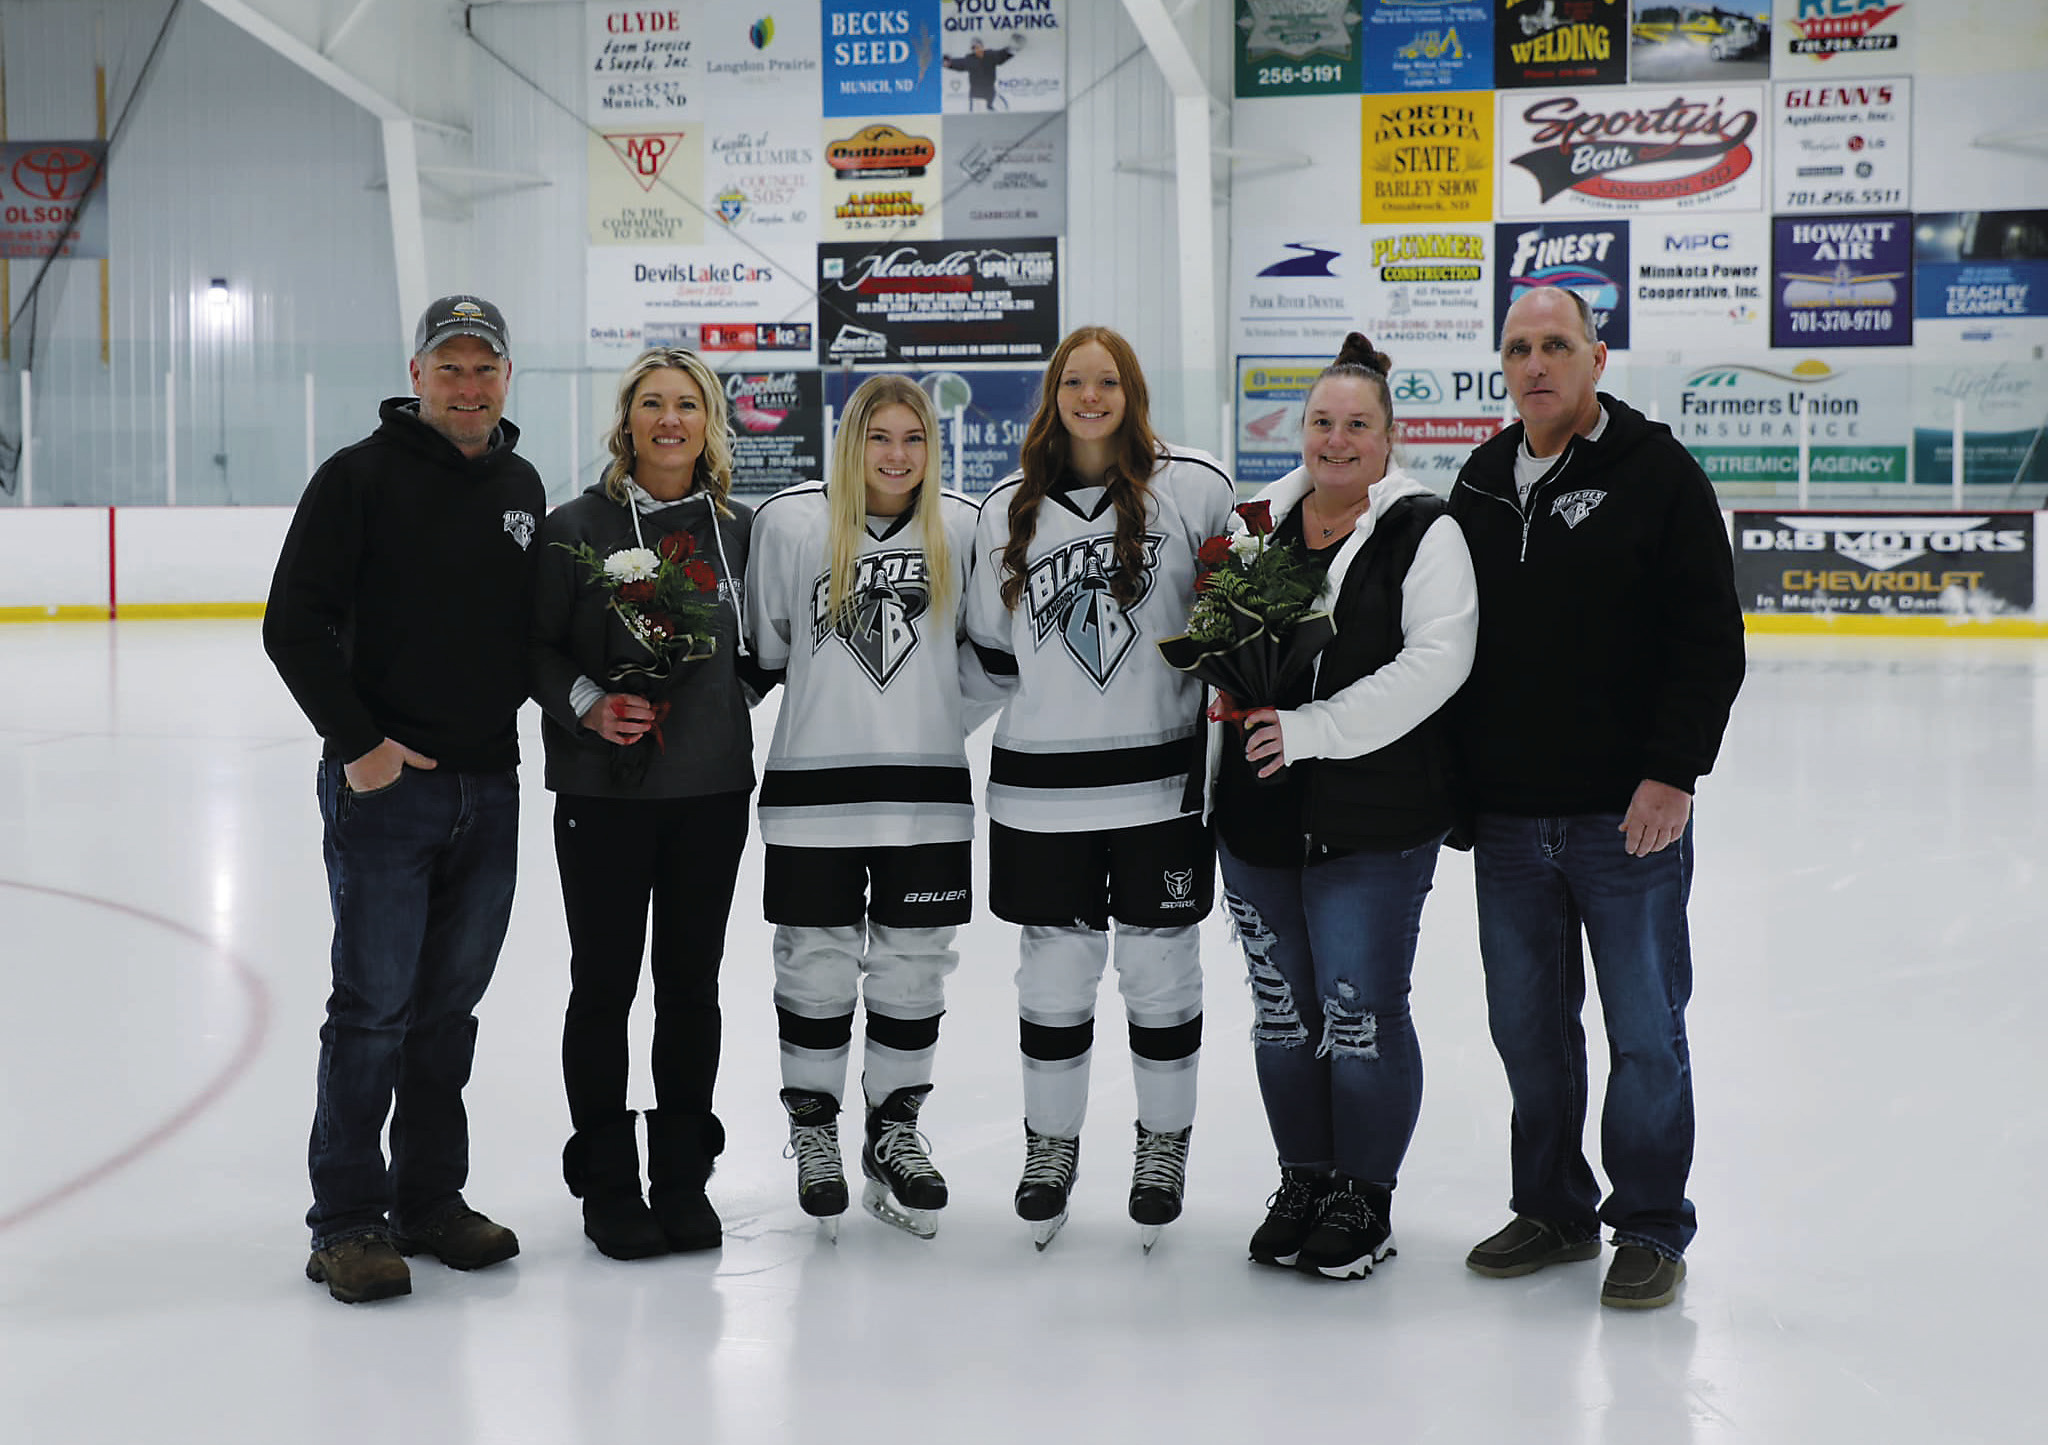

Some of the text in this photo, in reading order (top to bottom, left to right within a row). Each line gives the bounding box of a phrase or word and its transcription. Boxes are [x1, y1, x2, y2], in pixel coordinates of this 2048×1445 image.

[955, 0, 1051, 14] YOU CAN
[607, 11, 681, 34] CLYDE
[831, 10, 910, 35] BECKS
[944, 14, 1057, 32] QUIT VAPING.
[604, 38, 691, 54] Farm Service
[834, 40, 910, 66] SEED
[1511, 23, 1611, 64] WELDING
[706, 60, 817, 76] Langdon Prairie
[839, 79, 913, 95] MUNICH, ND
[1785, 86, 1895, 108] GLENN'S
[602, 96, 687, 110] Munich, ND
[1380, 104, 1474, 124] NORTH
[1374, 123, 1480, 144] DAKOTA
[723, 148, 812, 166] COLUMBUS
[833, 144, 929, 158] Outback
[1394, 146, 1460, 173] STATE
[1570, 145, 1632, 175] Bar
[1374, 179, 1480, 198] BARLEY SHOW
[1599, 166, 1732, 197] LANGDON ND
[5, 206, 80, 224] OLSON
[621, 207, 665, 219] IN THE
[602, 217, 683, 230] COMMUNITY
[632, 227, 675, 240] SERVE
[1792, 221, 1897, 244] HOWATT
[1371, 233, 1485, 268] PLUMMER
[1665, 232, 1730, 252] MPC
[1812, 241, 1876, 261] AIR
[1509, 228, 1617, 278] FINEST
[634, 262, 773, 283] Devils Lake Cars
[1384, 266, 1481, 281] CONSTRUCTION
[1639, 263, 1759, 279] Minnkota Power
[1945, 284, 2030, 301] TEACH BY
[1249, 295, 1345, 311] PARK RIVER DENTAL
[1790, 309, 1894, 332] 701-370-9710
[701, 326, 739, 347] Lake
[756, 325, 797, 347] Lake
[1456, 331, 1477, 341] ND
[753, 394, 799, 406] REALTY
[1681, 391, 1859, 416] Farmers Union
[985, 421, 997, 446] &
[1395, 419, 1496, 443] Technology
[962, 449, 1009, 465] angdon
[1810, 456, 1895, 474] AGENCY
[1742, 528, 2026, 554] D&B MOTORS
[1030, 538, 1163, 614] BLADS
[1781, 569, 1986, 593] CHEVROLET
[1756, 594, 1776, 608] In
[1867, 594, 1893, 610] Of
[904, 889, 967, 903] BAUER
